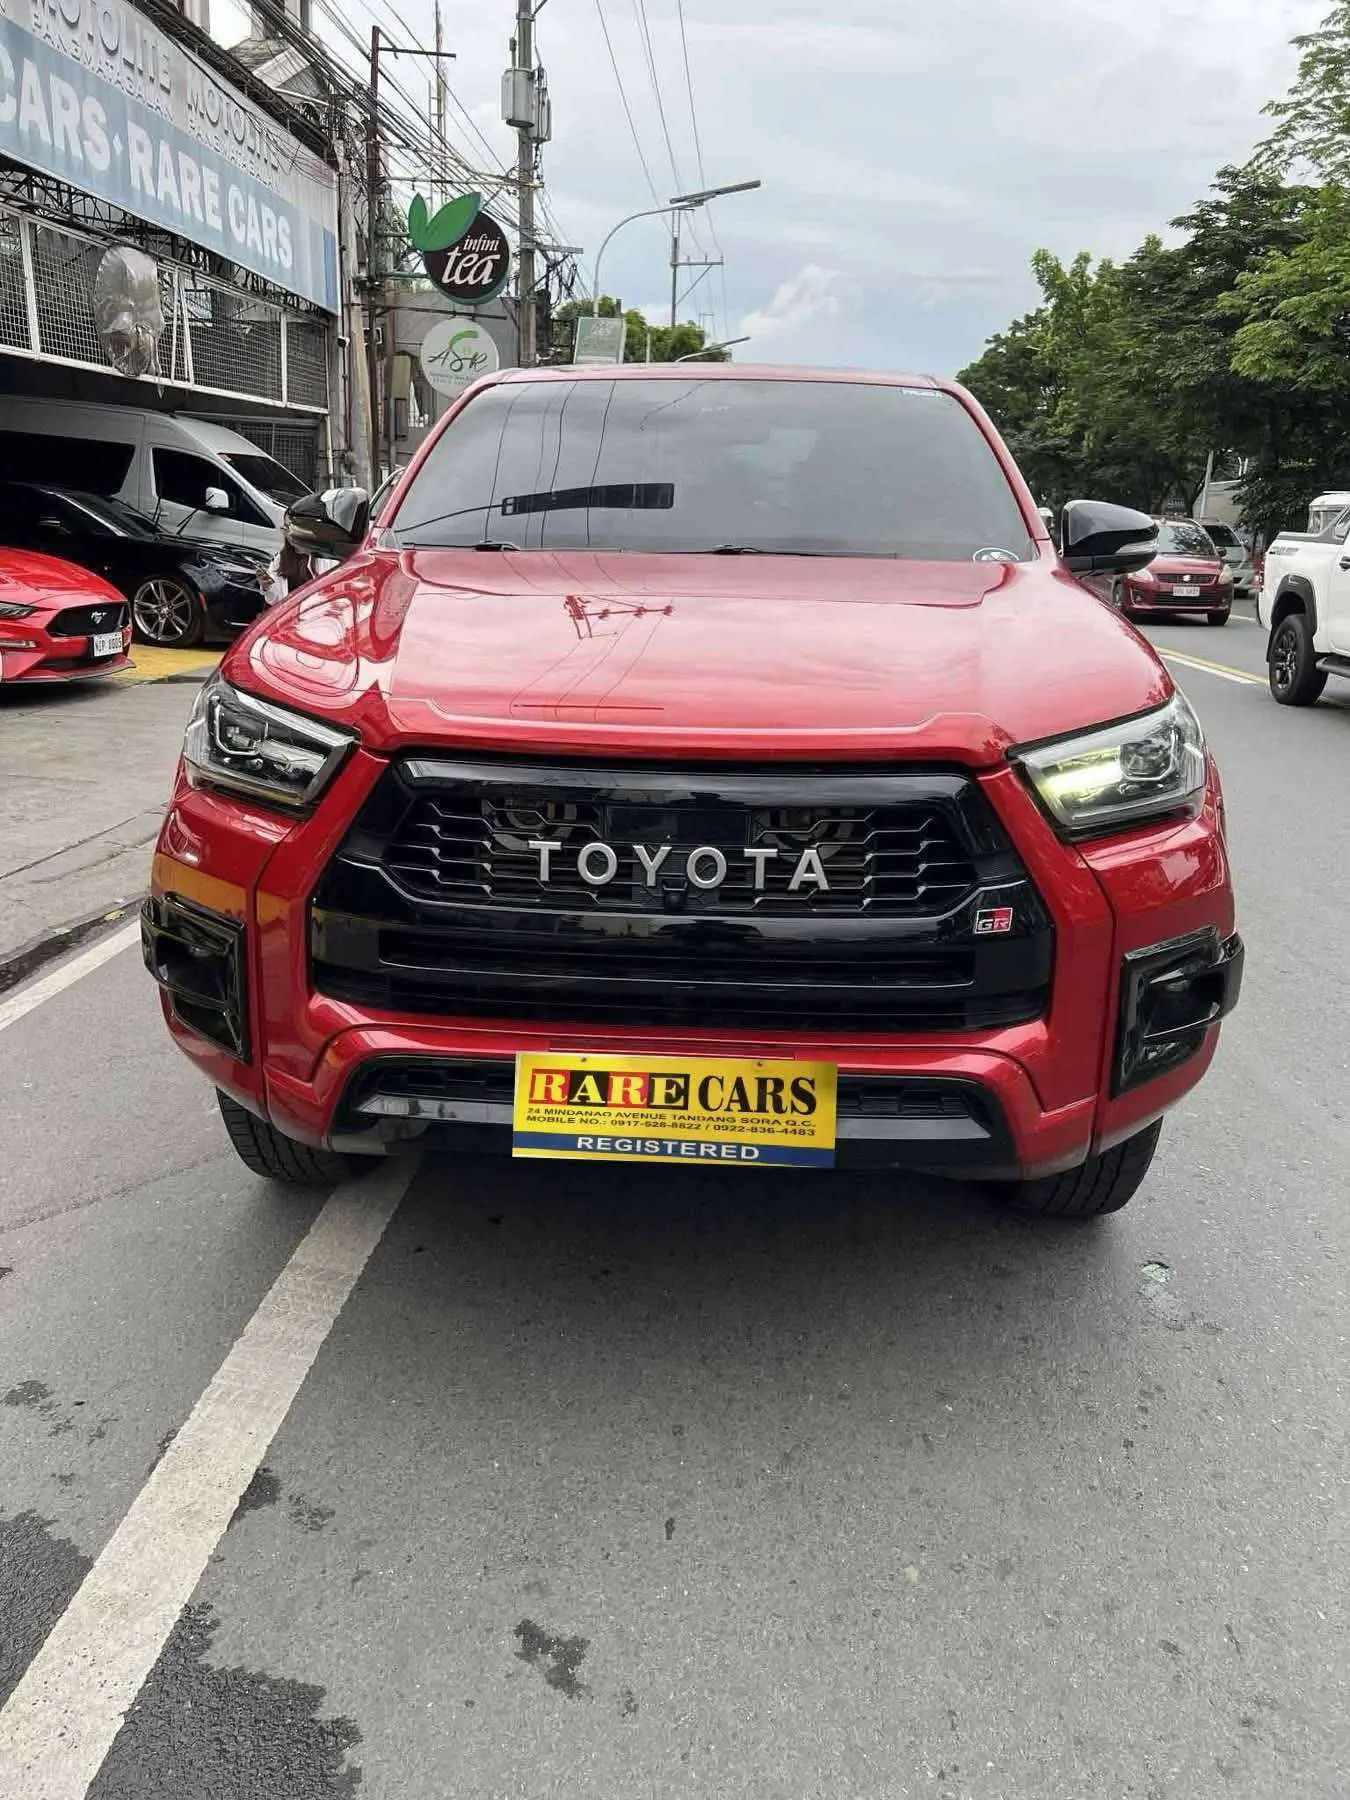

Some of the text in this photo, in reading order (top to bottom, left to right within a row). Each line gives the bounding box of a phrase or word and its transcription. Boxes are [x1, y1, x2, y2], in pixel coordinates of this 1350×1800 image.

[31, 0, 173, 95] OTOLITE
[127, 119, 223, 233] RARE
[228, 183, 293, 269] CARS
[463, 233, 501, 252] infini
[441, 246, 500, 285] tea
[528, 840, 830, 891] TOYOTA
[977, 917, 1010, 931] GR
[529, 1071, 817, 1116] RARE CARS
[526, 1115, 576, 1124] MOBILE
[544, 1108, 613, 1117] MINDANAO
[615, 1112, 667, 1120] AVENUE
[673, 1115, 736, 1124] TANDANG
[740, 1117, 782, 1126] SORA
[576, 1136, 760, 1160] REGISTERED
